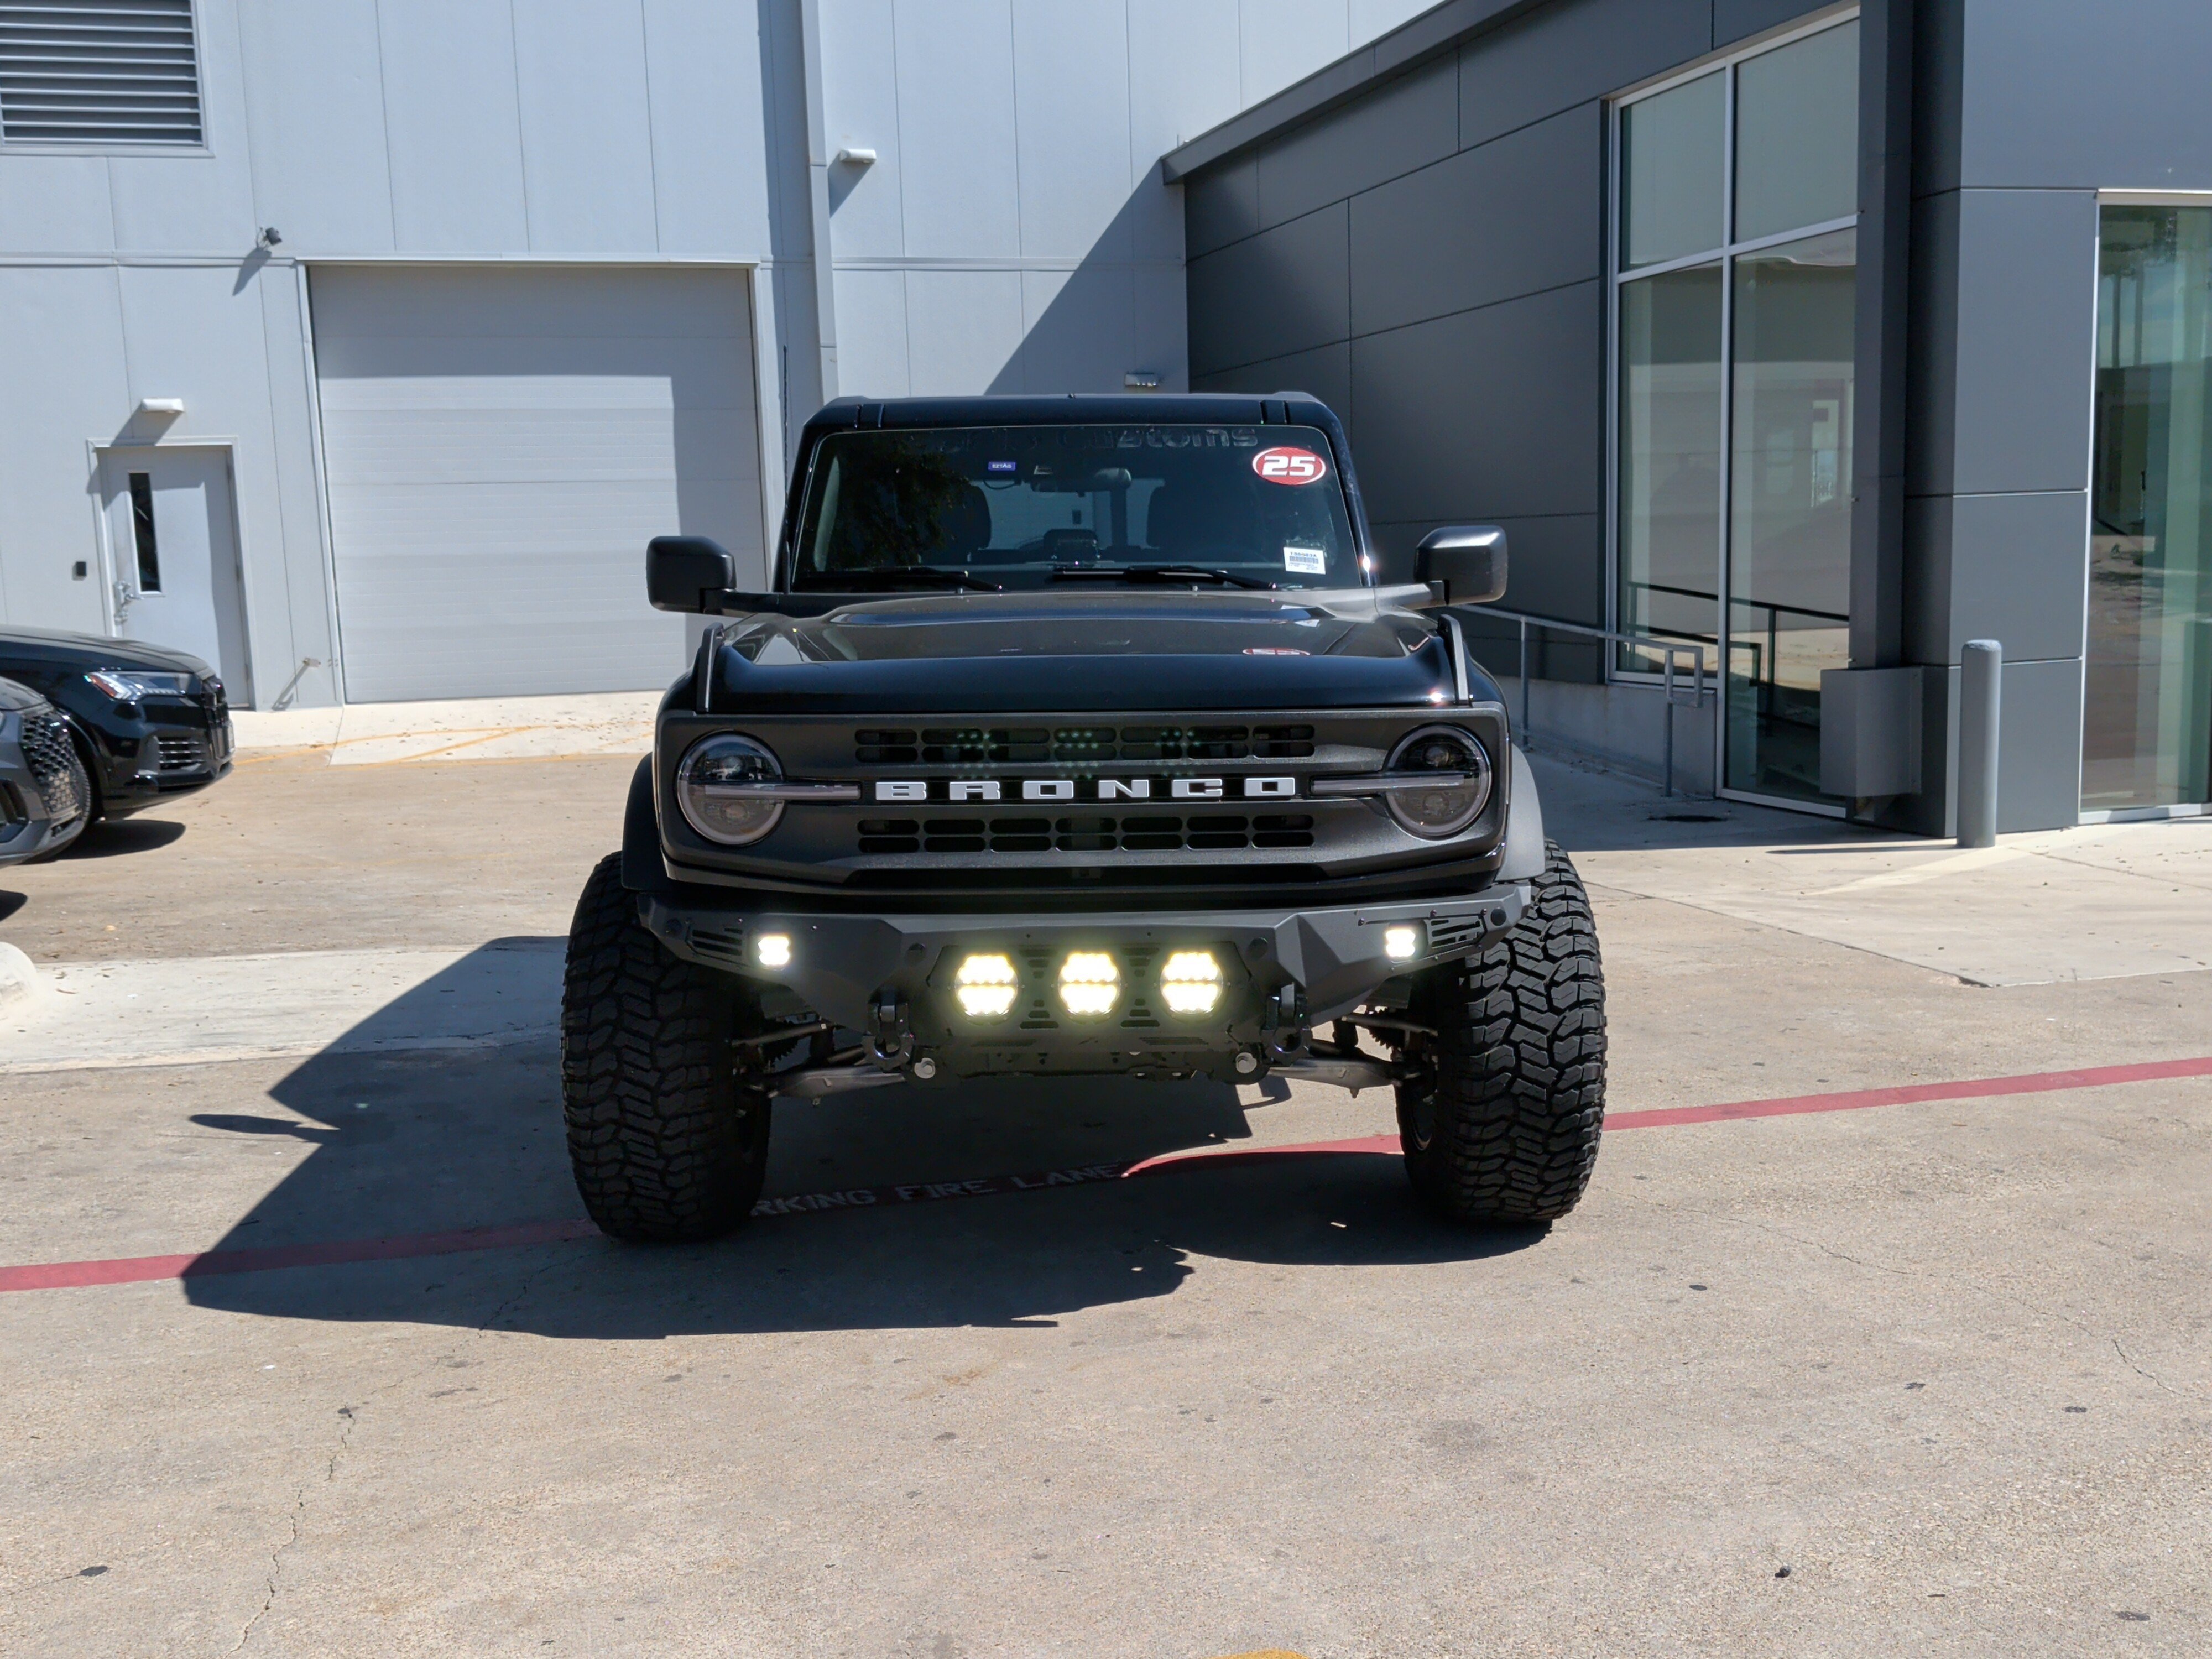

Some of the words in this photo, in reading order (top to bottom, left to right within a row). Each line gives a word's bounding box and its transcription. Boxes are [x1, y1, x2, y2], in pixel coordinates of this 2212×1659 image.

[1262, 456, 1315, 476] 25
[875, 777, 1295, 800] BRONCO
[750, 1190, 877, 1216] RKING
[894, 1180, 996, 1202] FIRE
[1009, 1164, 1121, 1188] LANE
